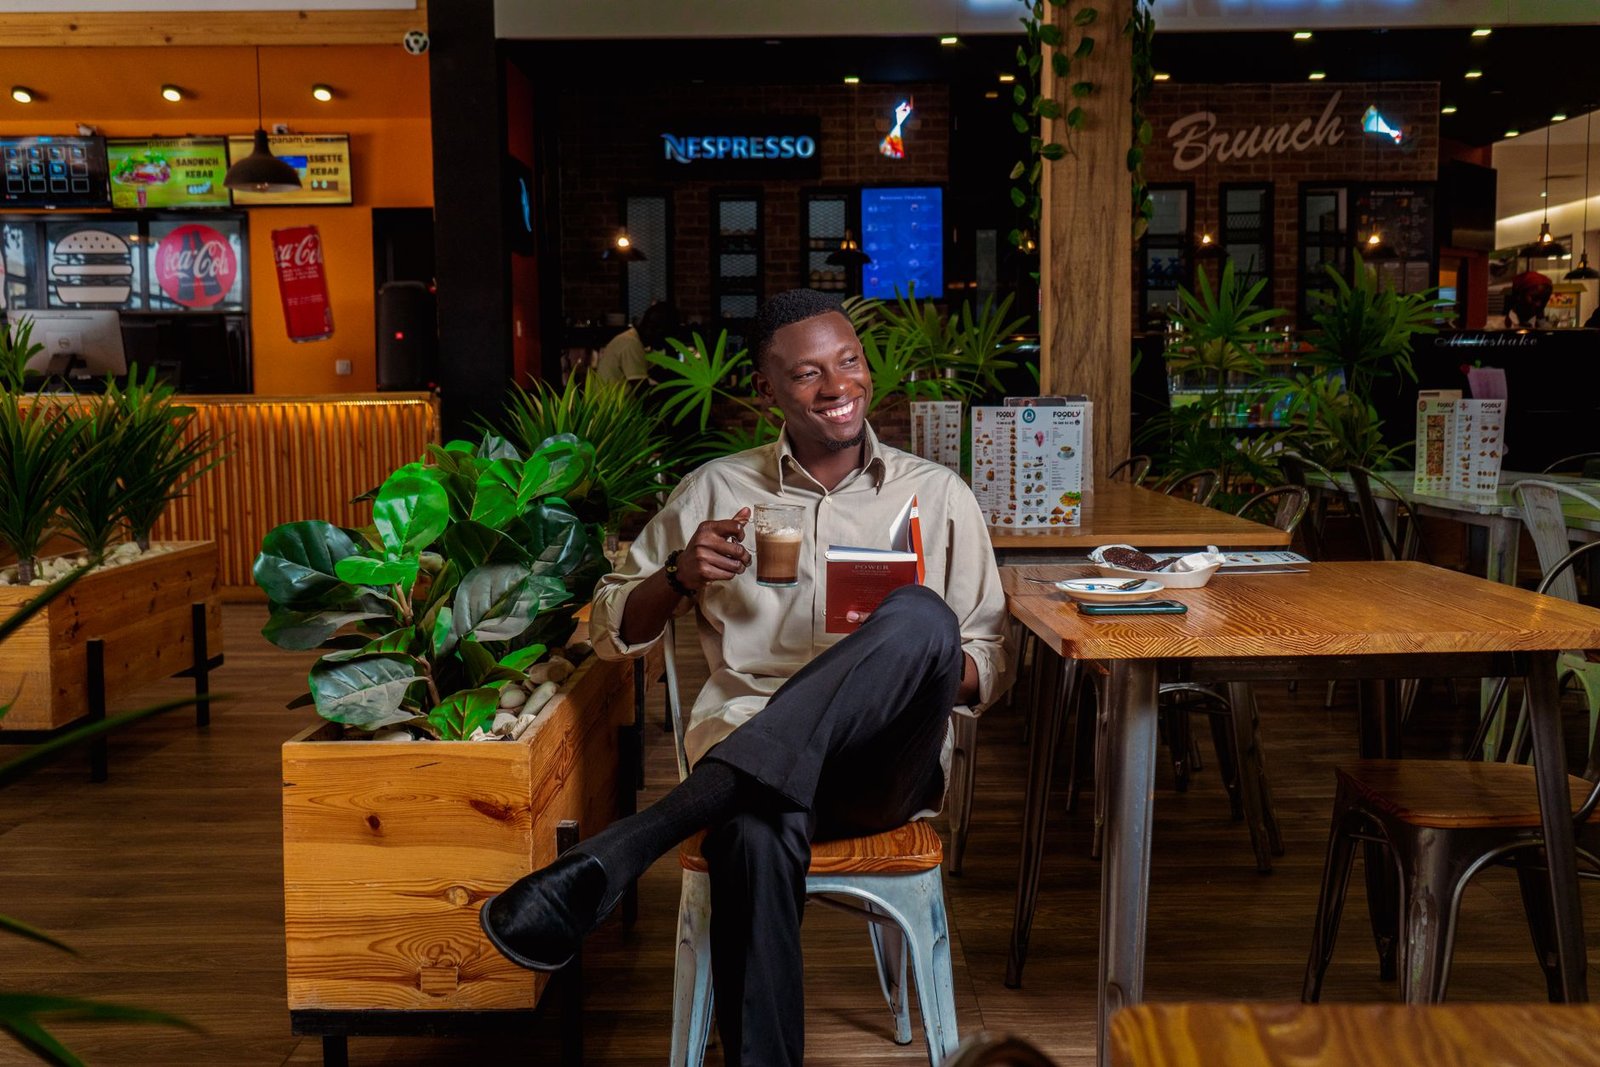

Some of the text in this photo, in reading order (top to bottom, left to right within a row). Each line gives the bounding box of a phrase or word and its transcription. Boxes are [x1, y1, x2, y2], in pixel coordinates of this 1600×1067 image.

[1168, 90, 1344, 171] Brunch
[661, 133, 816, 163] NESPRESSO
[176, 158, 219, 167] SANDWICH
[185, 170, 214, 178] KEBAB
[310, 167, 339, 176] KEBAB
[995, 410, 1016, 419] FOODLY
[1052, 410, 1081, 419] FOODLY
